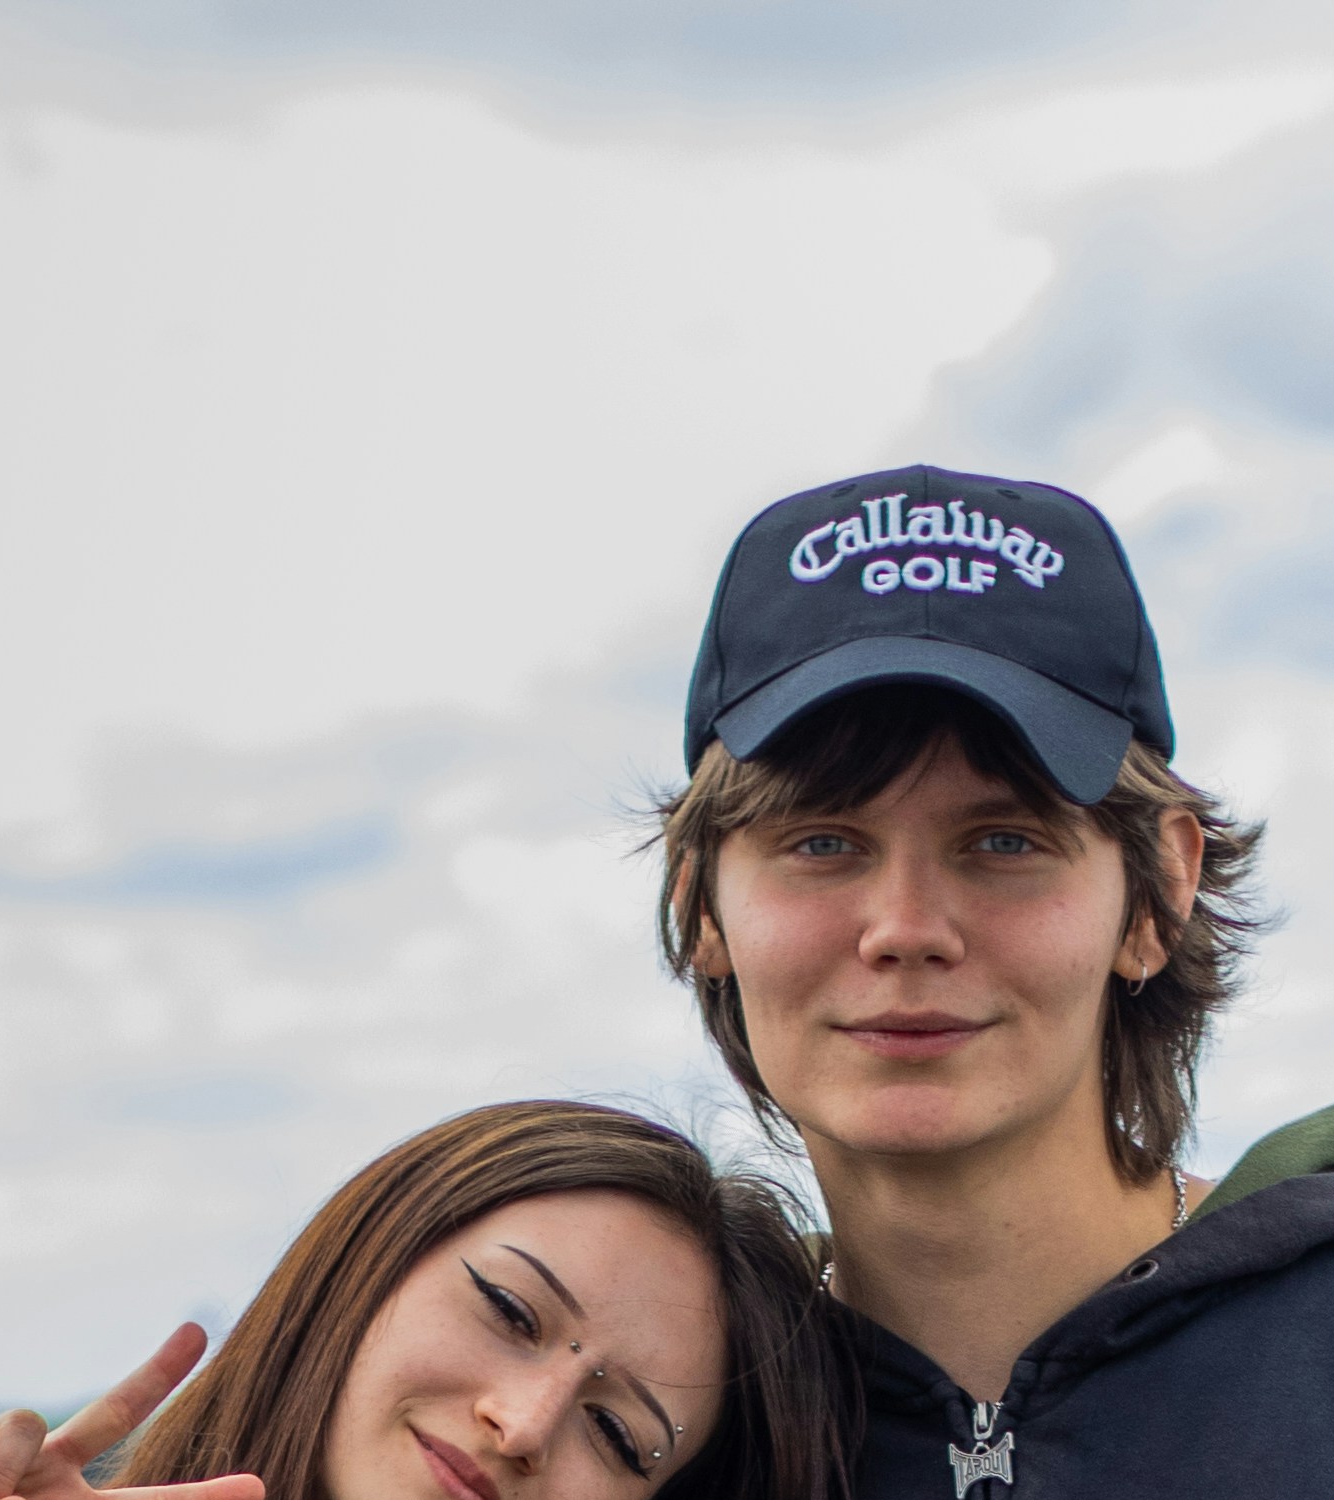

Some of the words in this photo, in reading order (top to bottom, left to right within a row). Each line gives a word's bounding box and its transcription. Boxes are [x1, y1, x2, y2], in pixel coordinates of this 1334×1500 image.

[789, 493, 1065, 588] Callaway
[862, 556, 997, 595] GOLF
[949, 1431, 1014, 1499] TAPOUT
